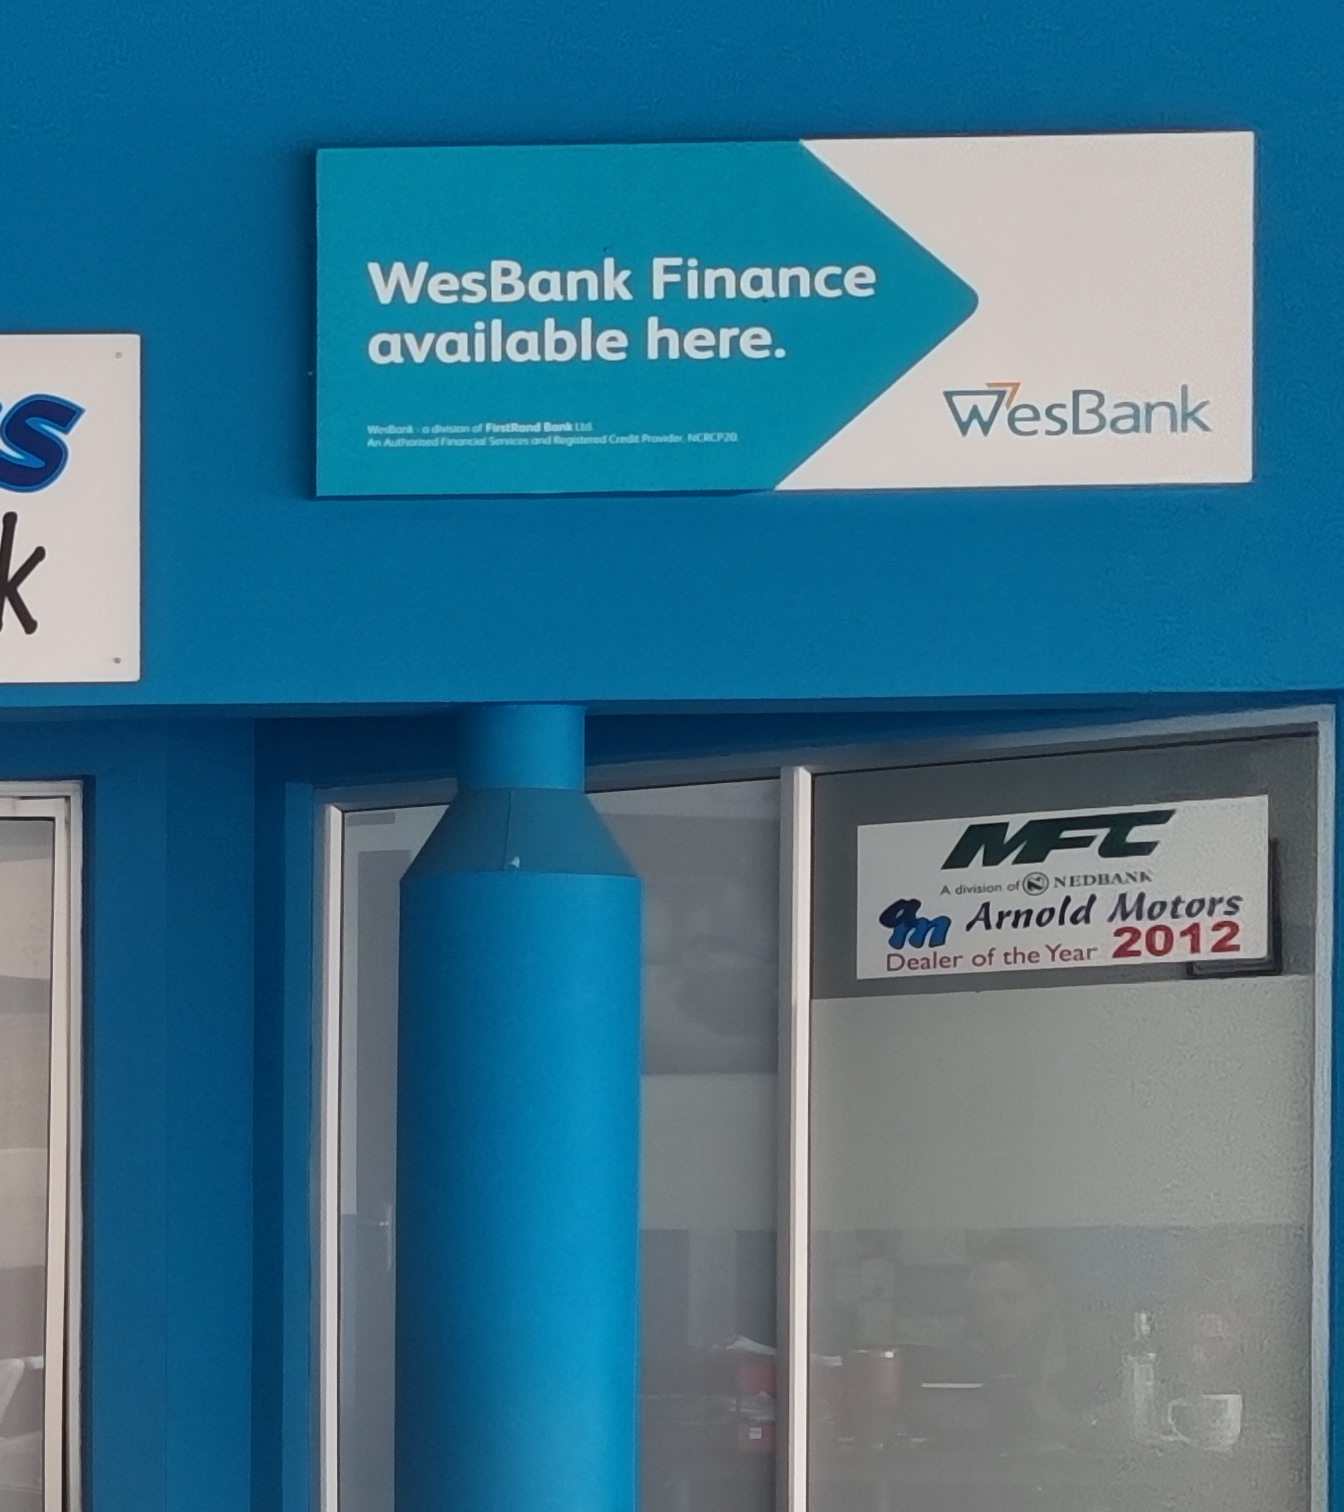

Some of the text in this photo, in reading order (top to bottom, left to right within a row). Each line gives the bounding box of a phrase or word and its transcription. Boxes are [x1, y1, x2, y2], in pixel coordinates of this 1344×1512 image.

[368, 257, 877, 304] WesBank Finance
[368, 317, 787, 364] available here.
[367, 425, 414, 434] WesBank
[431, 424, 470, 434] division
[472, 423, 483, 433] of
[485, 422, 541, 433] FirstRand
[543, 422, 573, 432] Bank
[943, 383, 1212, 438] WesBank
[367, 438, 382, 447] An
[384, 437, 439, 447] Authorised
[440, 436, 486, 446] Financial
[489, 437, 529, 446] Services
[531, 435, 552, 445] and
[553, 434, 606, 447] Registered
[608, 434, 640, 444] Credit
[940, 809, 1177, 870] MFC
[940, 870, 1153, 895] A division of NEDBANK
[966, 893, 1098, 932] Arnold
[1107, 891, 1243, 923] Motors
[887, 920, 1241, 972] Dealer of the Year 2012
